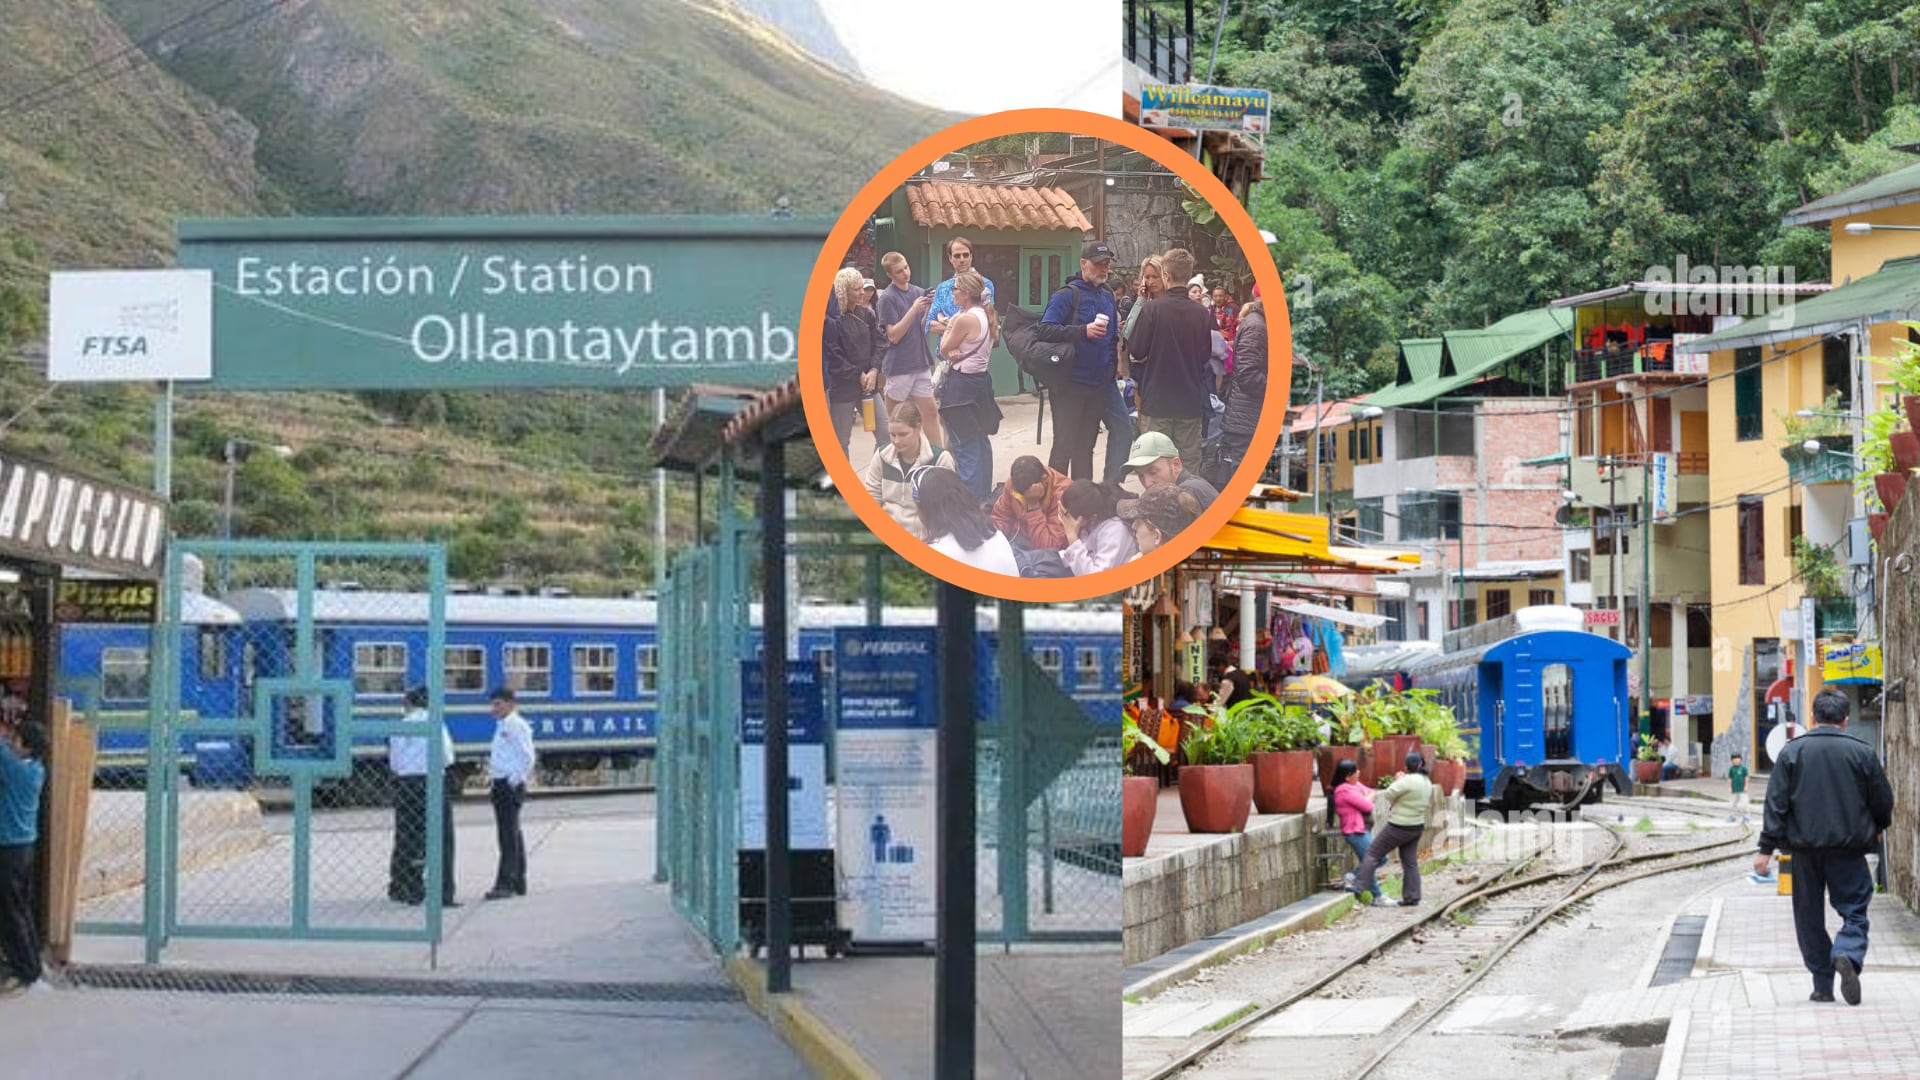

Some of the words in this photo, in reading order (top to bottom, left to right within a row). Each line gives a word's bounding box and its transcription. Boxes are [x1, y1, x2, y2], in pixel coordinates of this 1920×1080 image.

[1144, 84, 1265, 110] Willcamayu
[236, 256, 434, 296] Estación
[449, 255, 468, 297] /
[482, 255, 653, 294] Station
[82, 336, 147, 356] FTSA
[411, 311, 796, 374] Ollantaytamb
[1656, 455, 1667, 507] HOSTAL
[0, 458, 161, 567] APUCCINO
[57, 582, 154, 605] Pizzas
[528, 717, 647, 733] RURAIL
